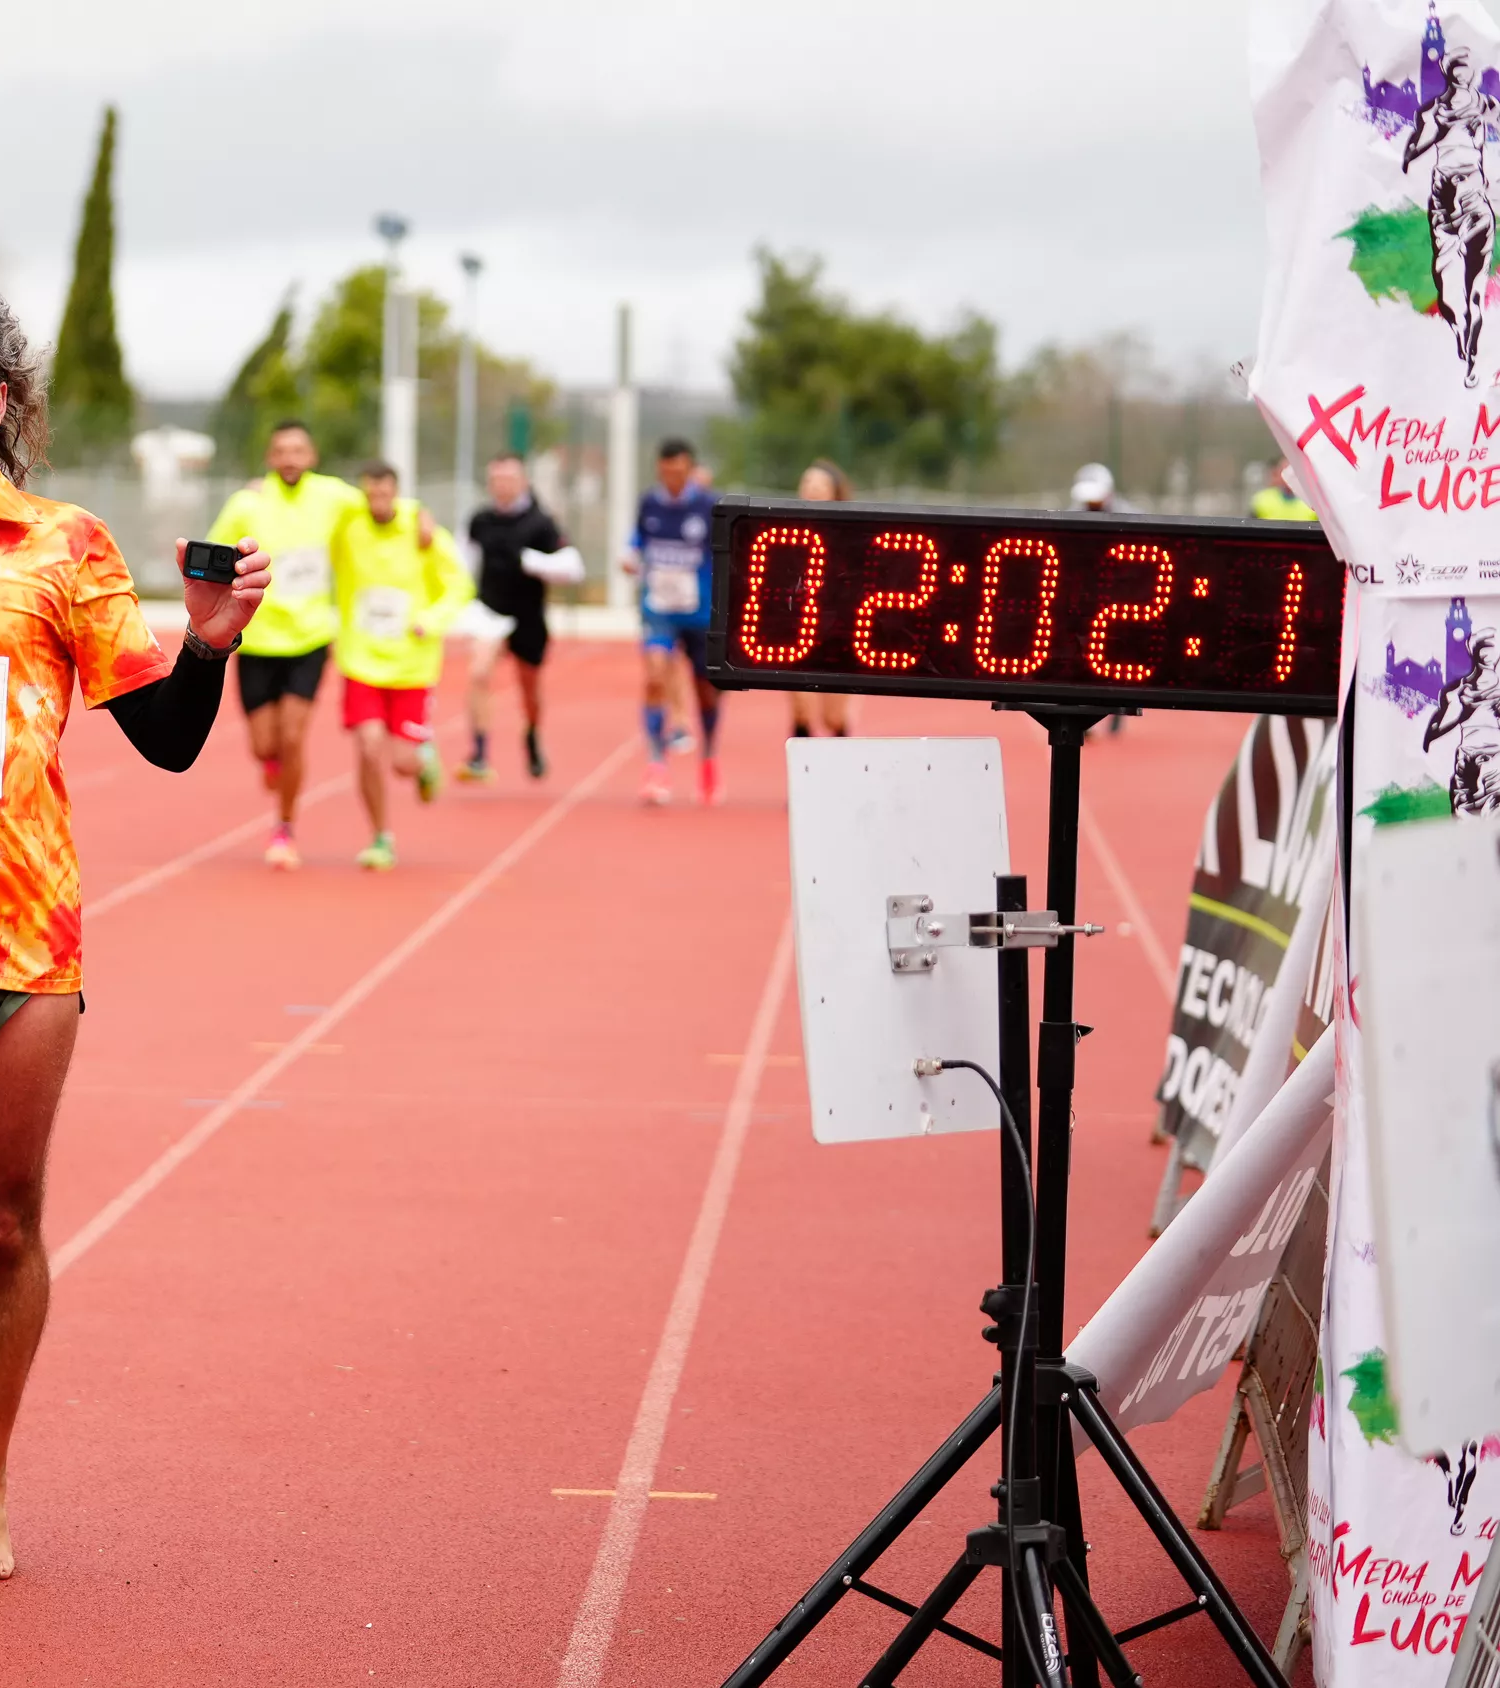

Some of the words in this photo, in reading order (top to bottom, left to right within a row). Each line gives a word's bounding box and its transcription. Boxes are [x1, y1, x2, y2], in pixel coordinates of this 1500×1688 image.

[1405, 446, 1460, 465] CIUDAD
[1467, 447, 1489, 462] DE
[1333, 1541, 1429, 1592] MEDIA
[1382, 1589, 1437, 1608] CIUDAD
[1443, 1593, 1467, 1607] DE
[1041, 1612, 1059, 1659] ibiza
